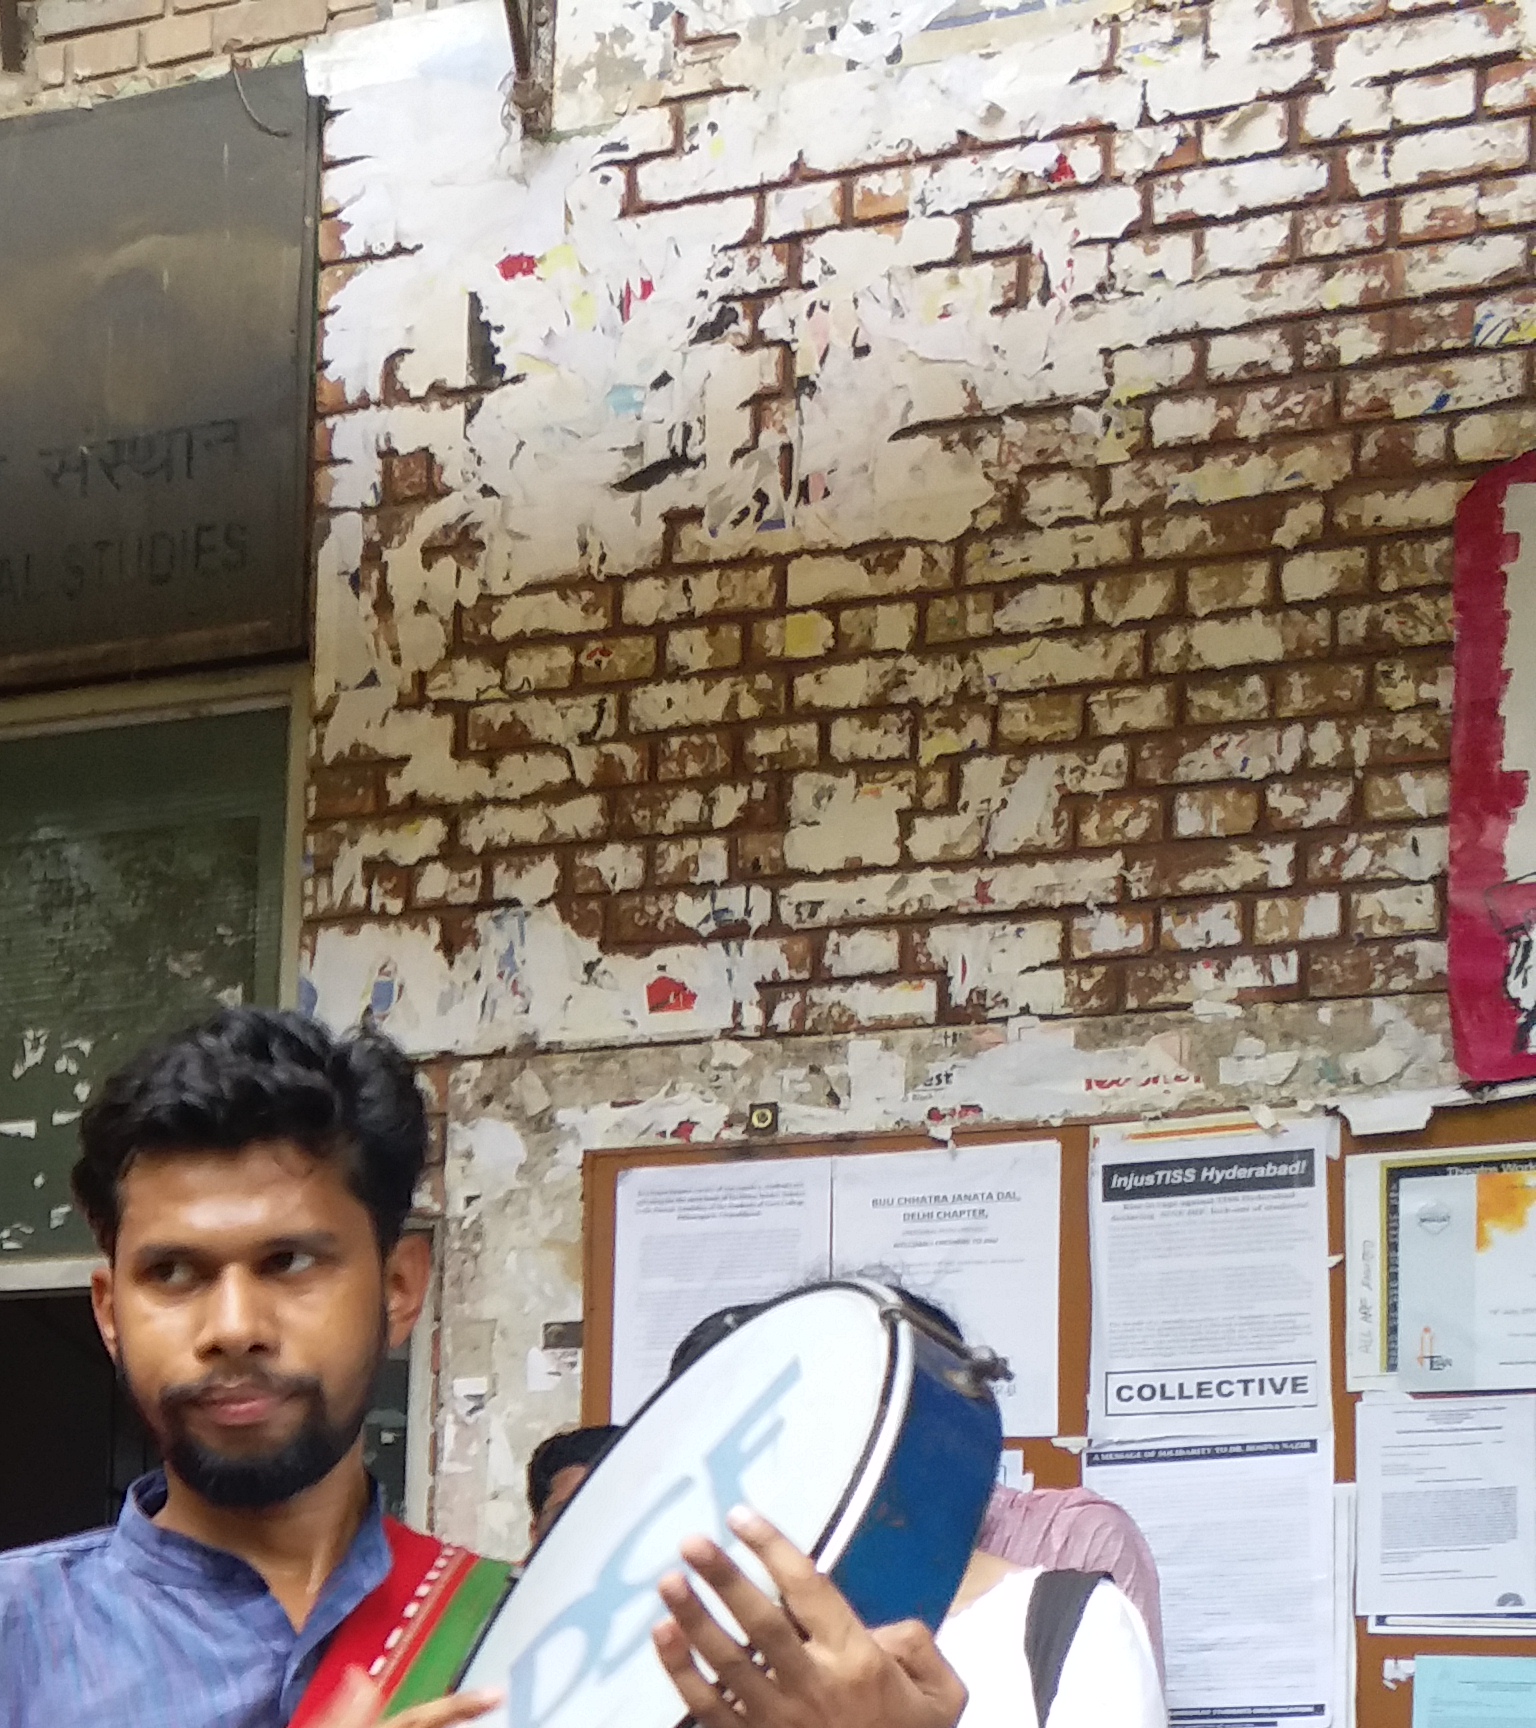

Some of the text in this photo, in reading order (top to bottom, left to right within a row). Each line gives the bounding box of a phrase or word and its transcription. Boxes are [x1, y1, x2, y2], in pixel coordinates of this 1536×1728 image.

[60, 519, 249, 604] STUDIES
[1110, 1159, 1307, 1191] InjusTISS Hyderabad!
[896, 1193, 949, 1208] CHHATRA
[950, 1190, 995, 1206] JANATA
[902, 1209, 934, 1222] DELHI
[1115, 1375, 1310, 1404] COLLECTIVE
